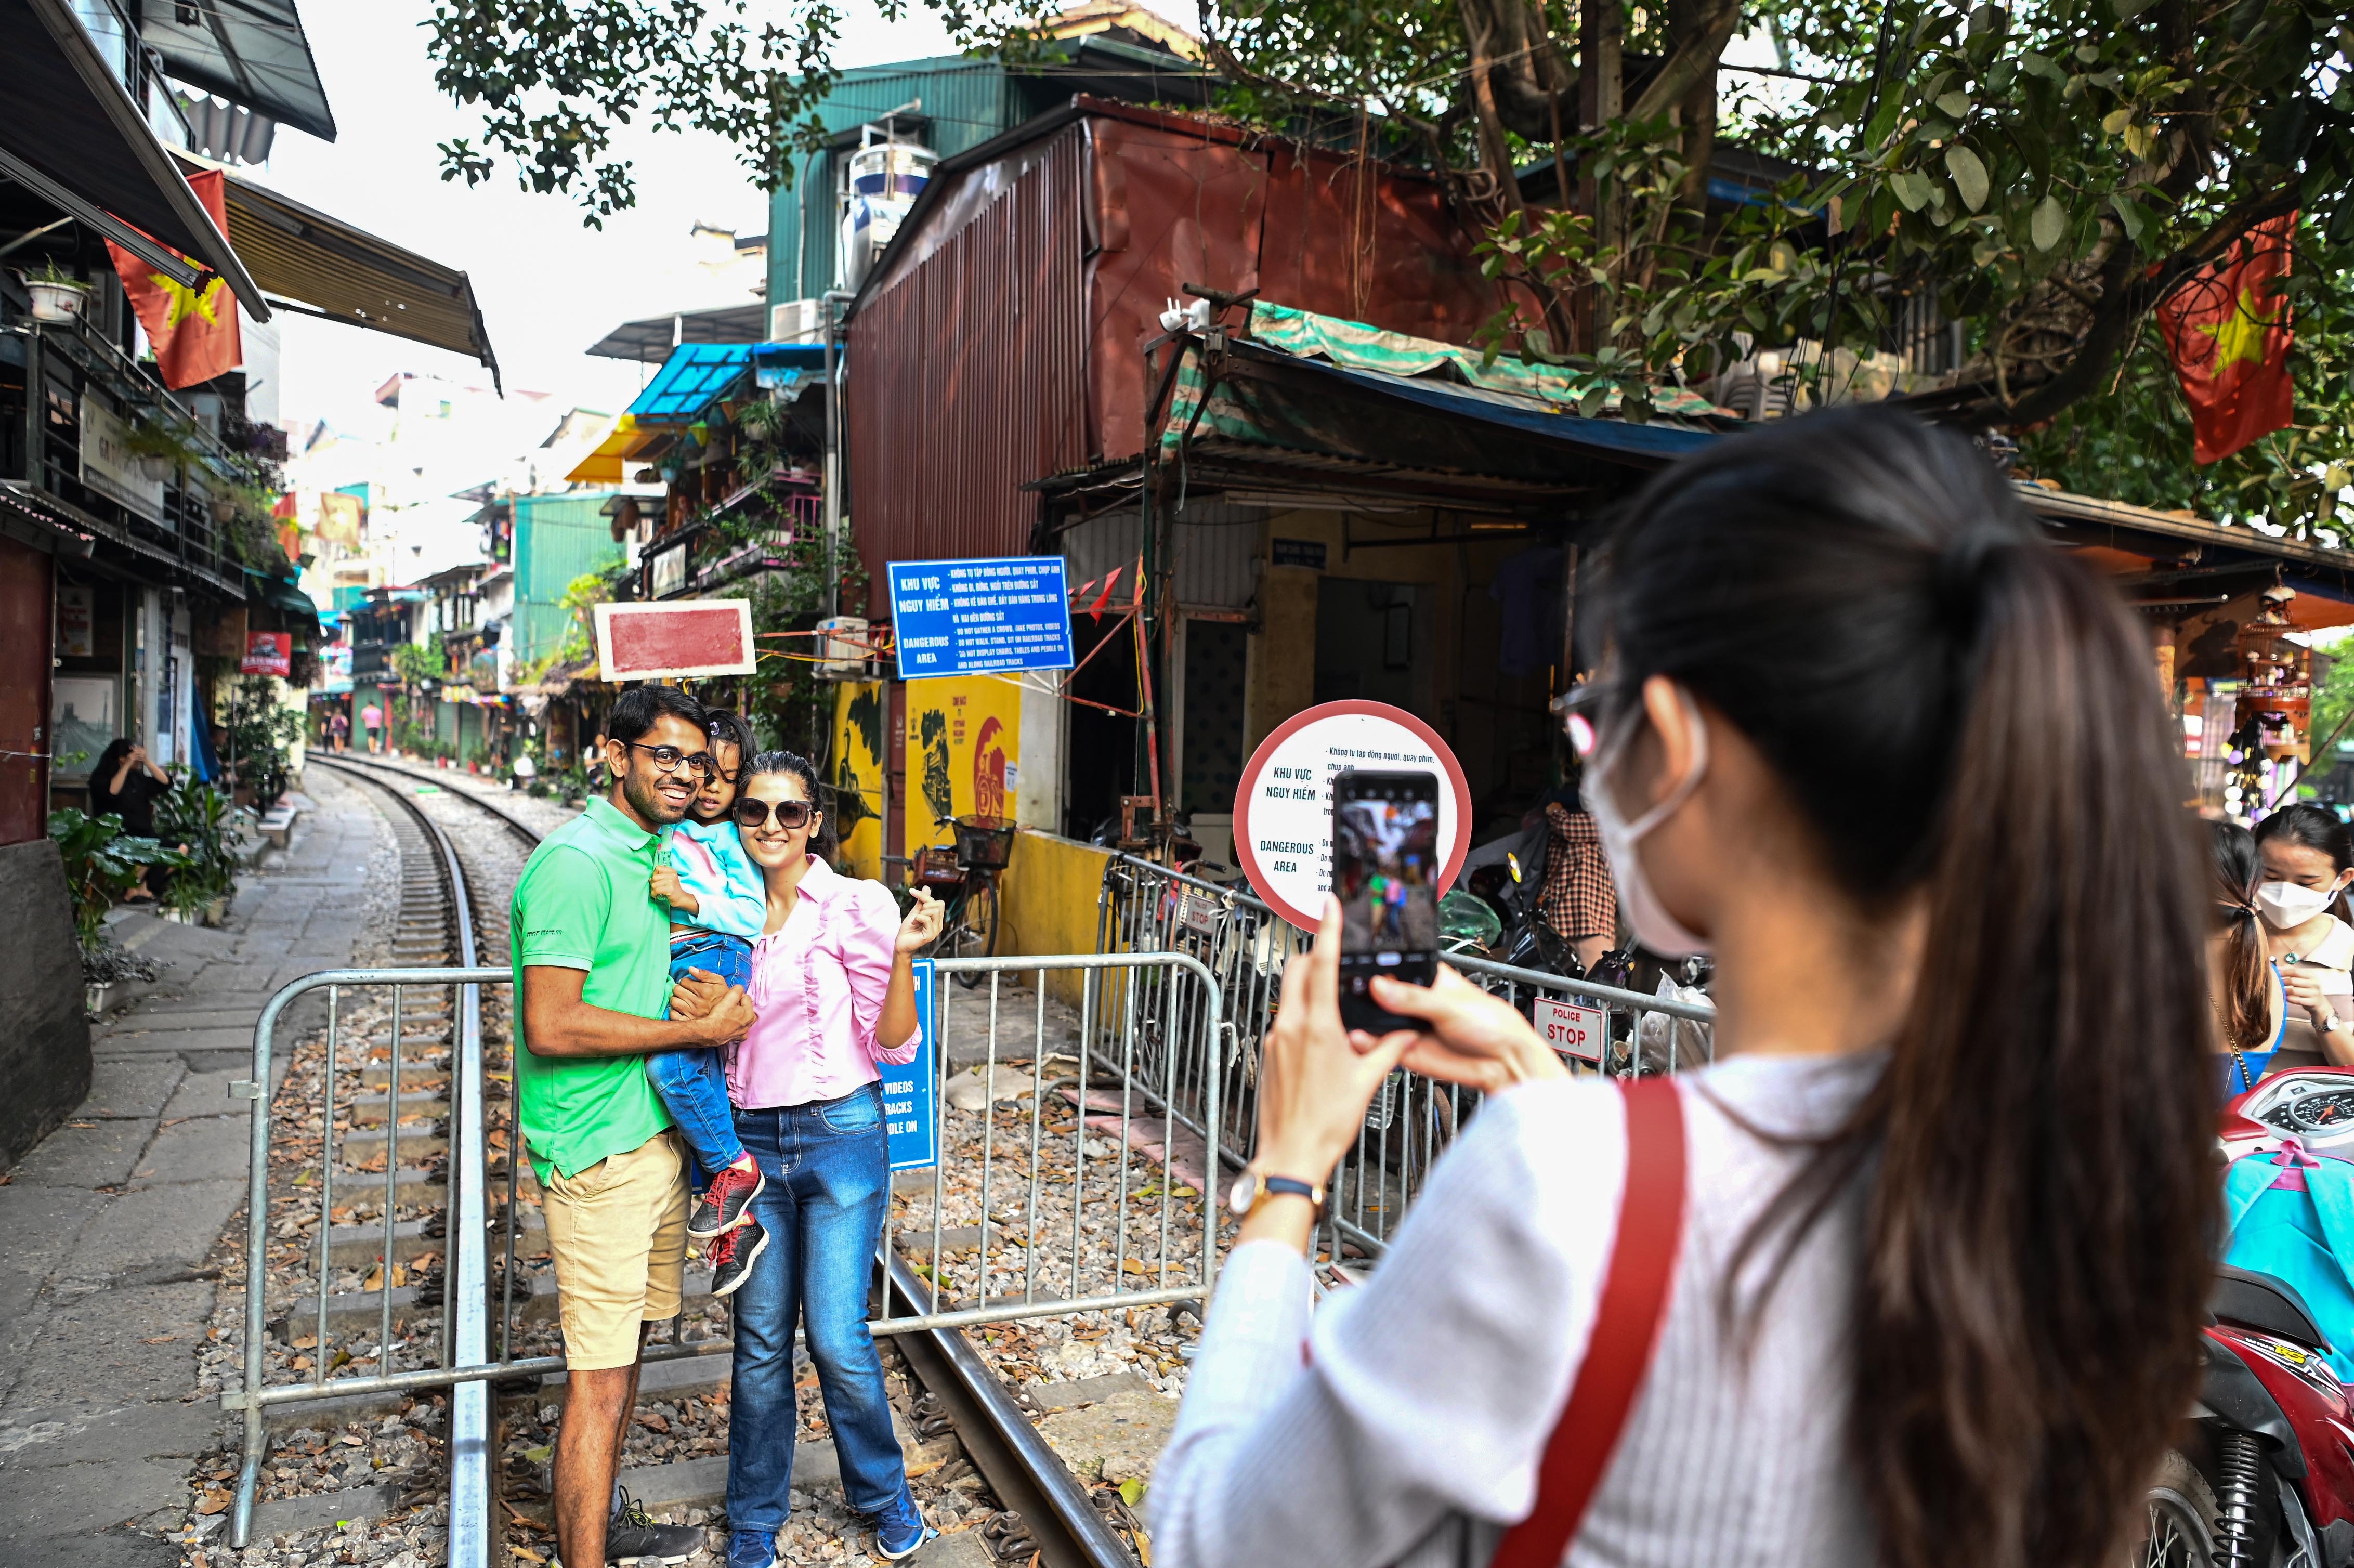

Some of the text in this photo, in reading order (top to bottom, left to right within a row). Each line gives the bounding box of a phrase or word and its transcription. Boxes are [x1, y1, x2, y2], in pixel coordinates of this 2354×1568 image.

[900, 576, 940, 593] KHU VỰC
[899, 593, 949, 613] NGUY HIỂM
[903, 636, 949, 649] DANGEROUS
[917, 653, 937, 664] AREA
[1404, 754, 1417, 762] quay
[1274, 767, 1291, 779] KHU
[1295, 768, 1312, 782] VỰC
[1266, 787, 1290, 799] NGUY
[1293, 785, 1315, 801] HIỂM
[1260, 840, 1314, 855] DANGEROUS
[1321, 854, 1327, 862] Do
[1274, 861, 1297, 872] AREA
[1192, 911, 1208, 925] STOP
[1553, 1008, 1580, 1022] POLICE
[1547, 1023, 1586, 1046] STOP
[884, 1080, 914, 1095] VIDEOS
[884, 1101, 912, 1116] RACKS
[906, 1120, 917, 1133] ON
